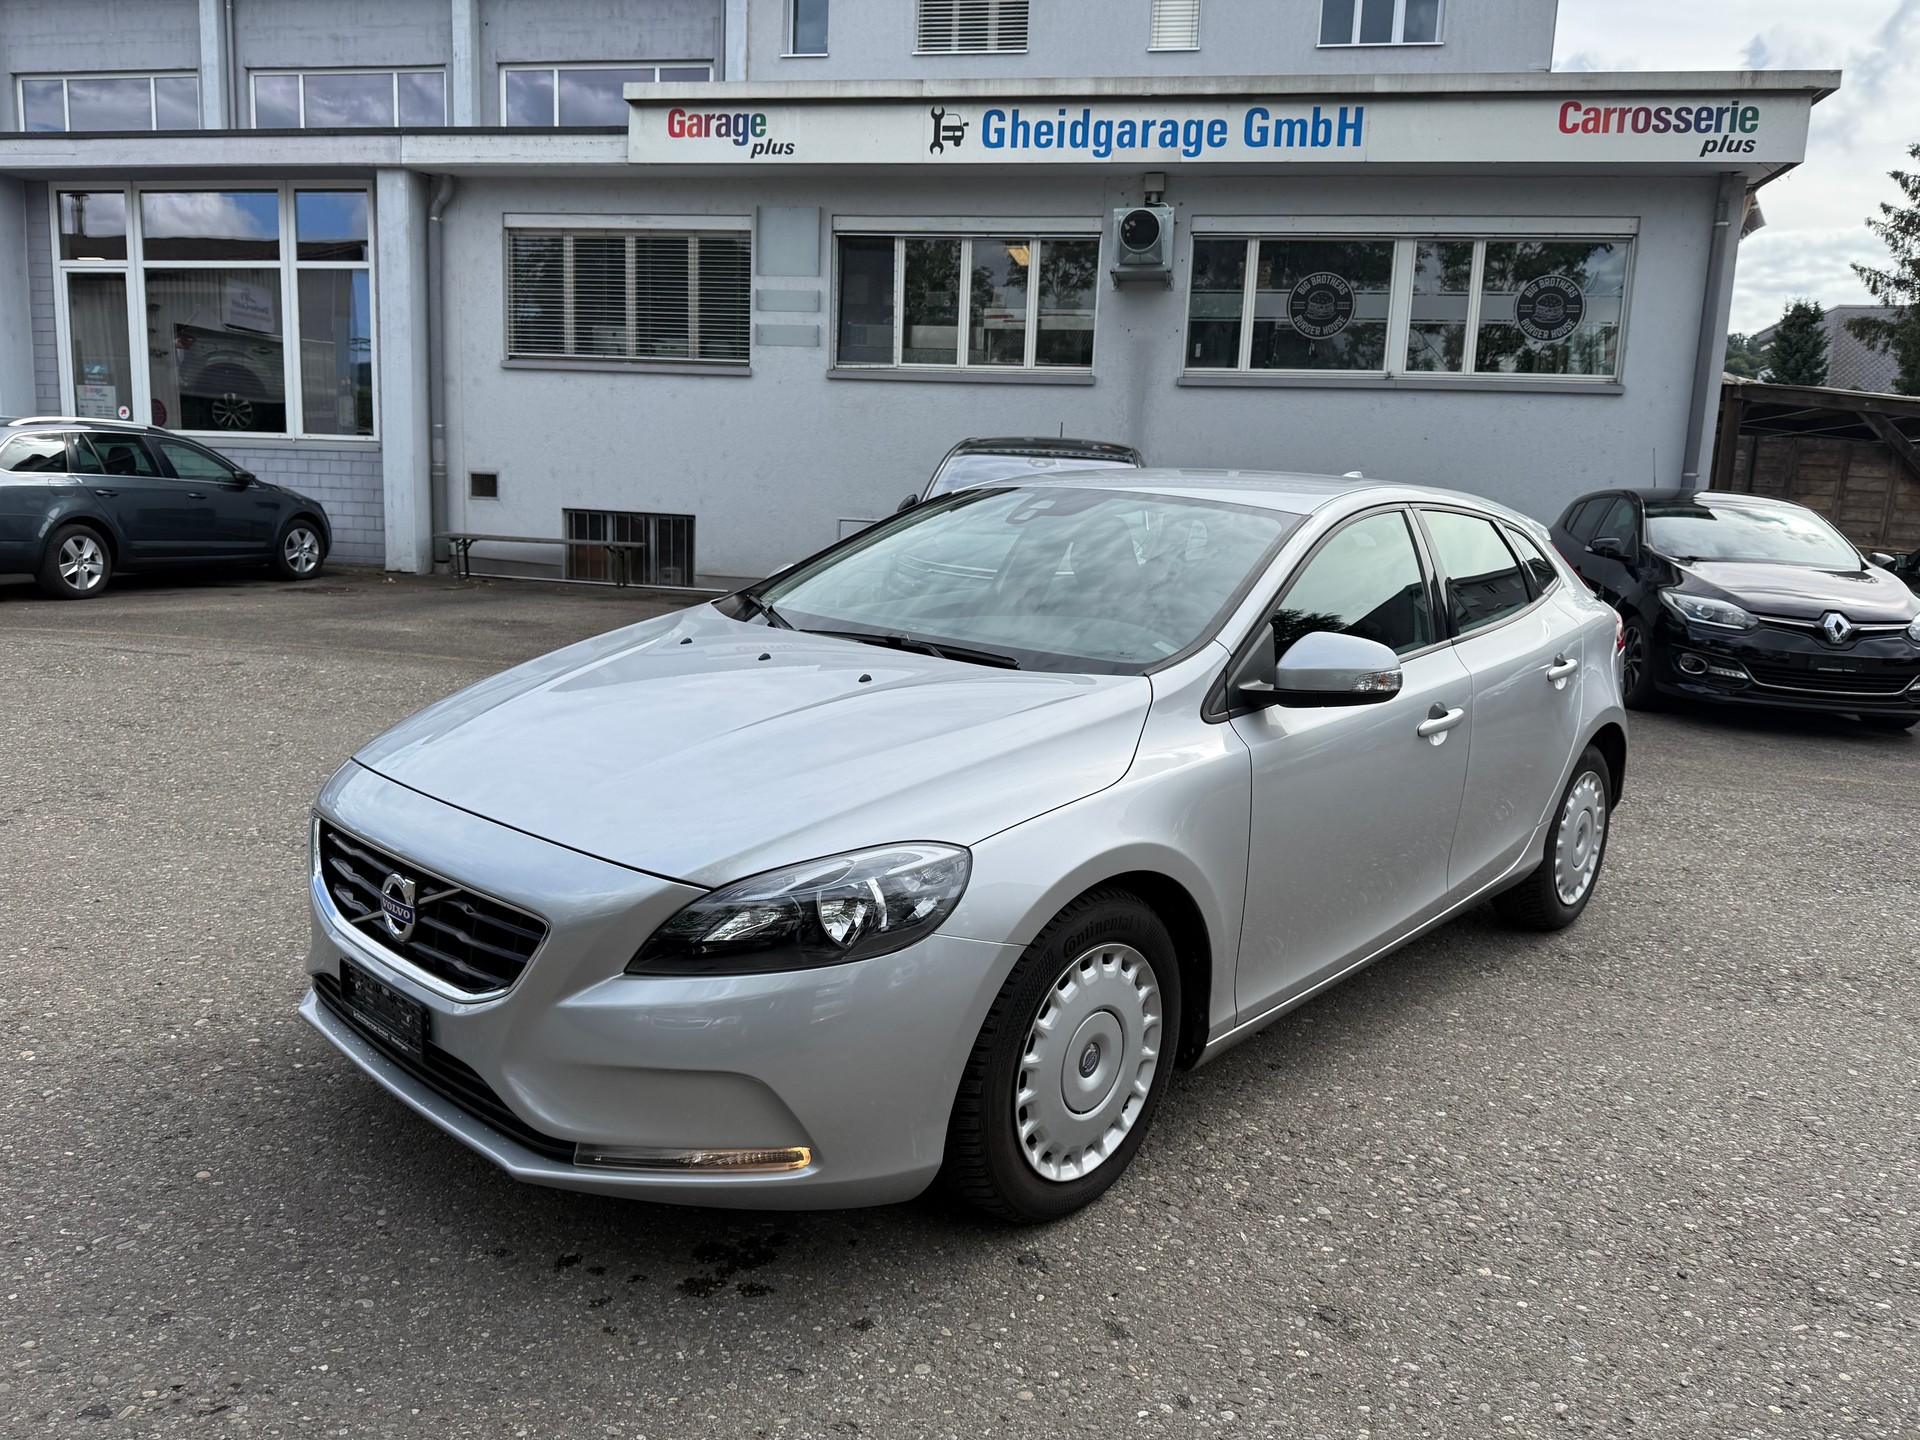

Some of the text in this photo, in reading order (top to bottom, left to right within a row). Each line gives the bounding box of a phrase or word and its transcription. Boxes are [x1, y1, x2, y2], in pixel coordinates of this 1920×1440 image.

[668, 108, 767, 146] Garage
[1559, 100, 1760, 134] Carrosserie
[982, 106, 1364, 158] Gheidgarage GmbH
[750, 138, 795, 158] plus
[1700, 134, 1757, 157] plus
[1297, 275, 1349, 296] BIG BROTHERS
[1524, 278, 1579, 298] BIG BROTHERS
[1294, 314, 1347, 336] BURGER HOUSE
[1520, 318, 1577, 340] BURGER HOUSE
[383, 897, 410, 919] VOLVO
[1063, 914, 1134, 958] Continental
